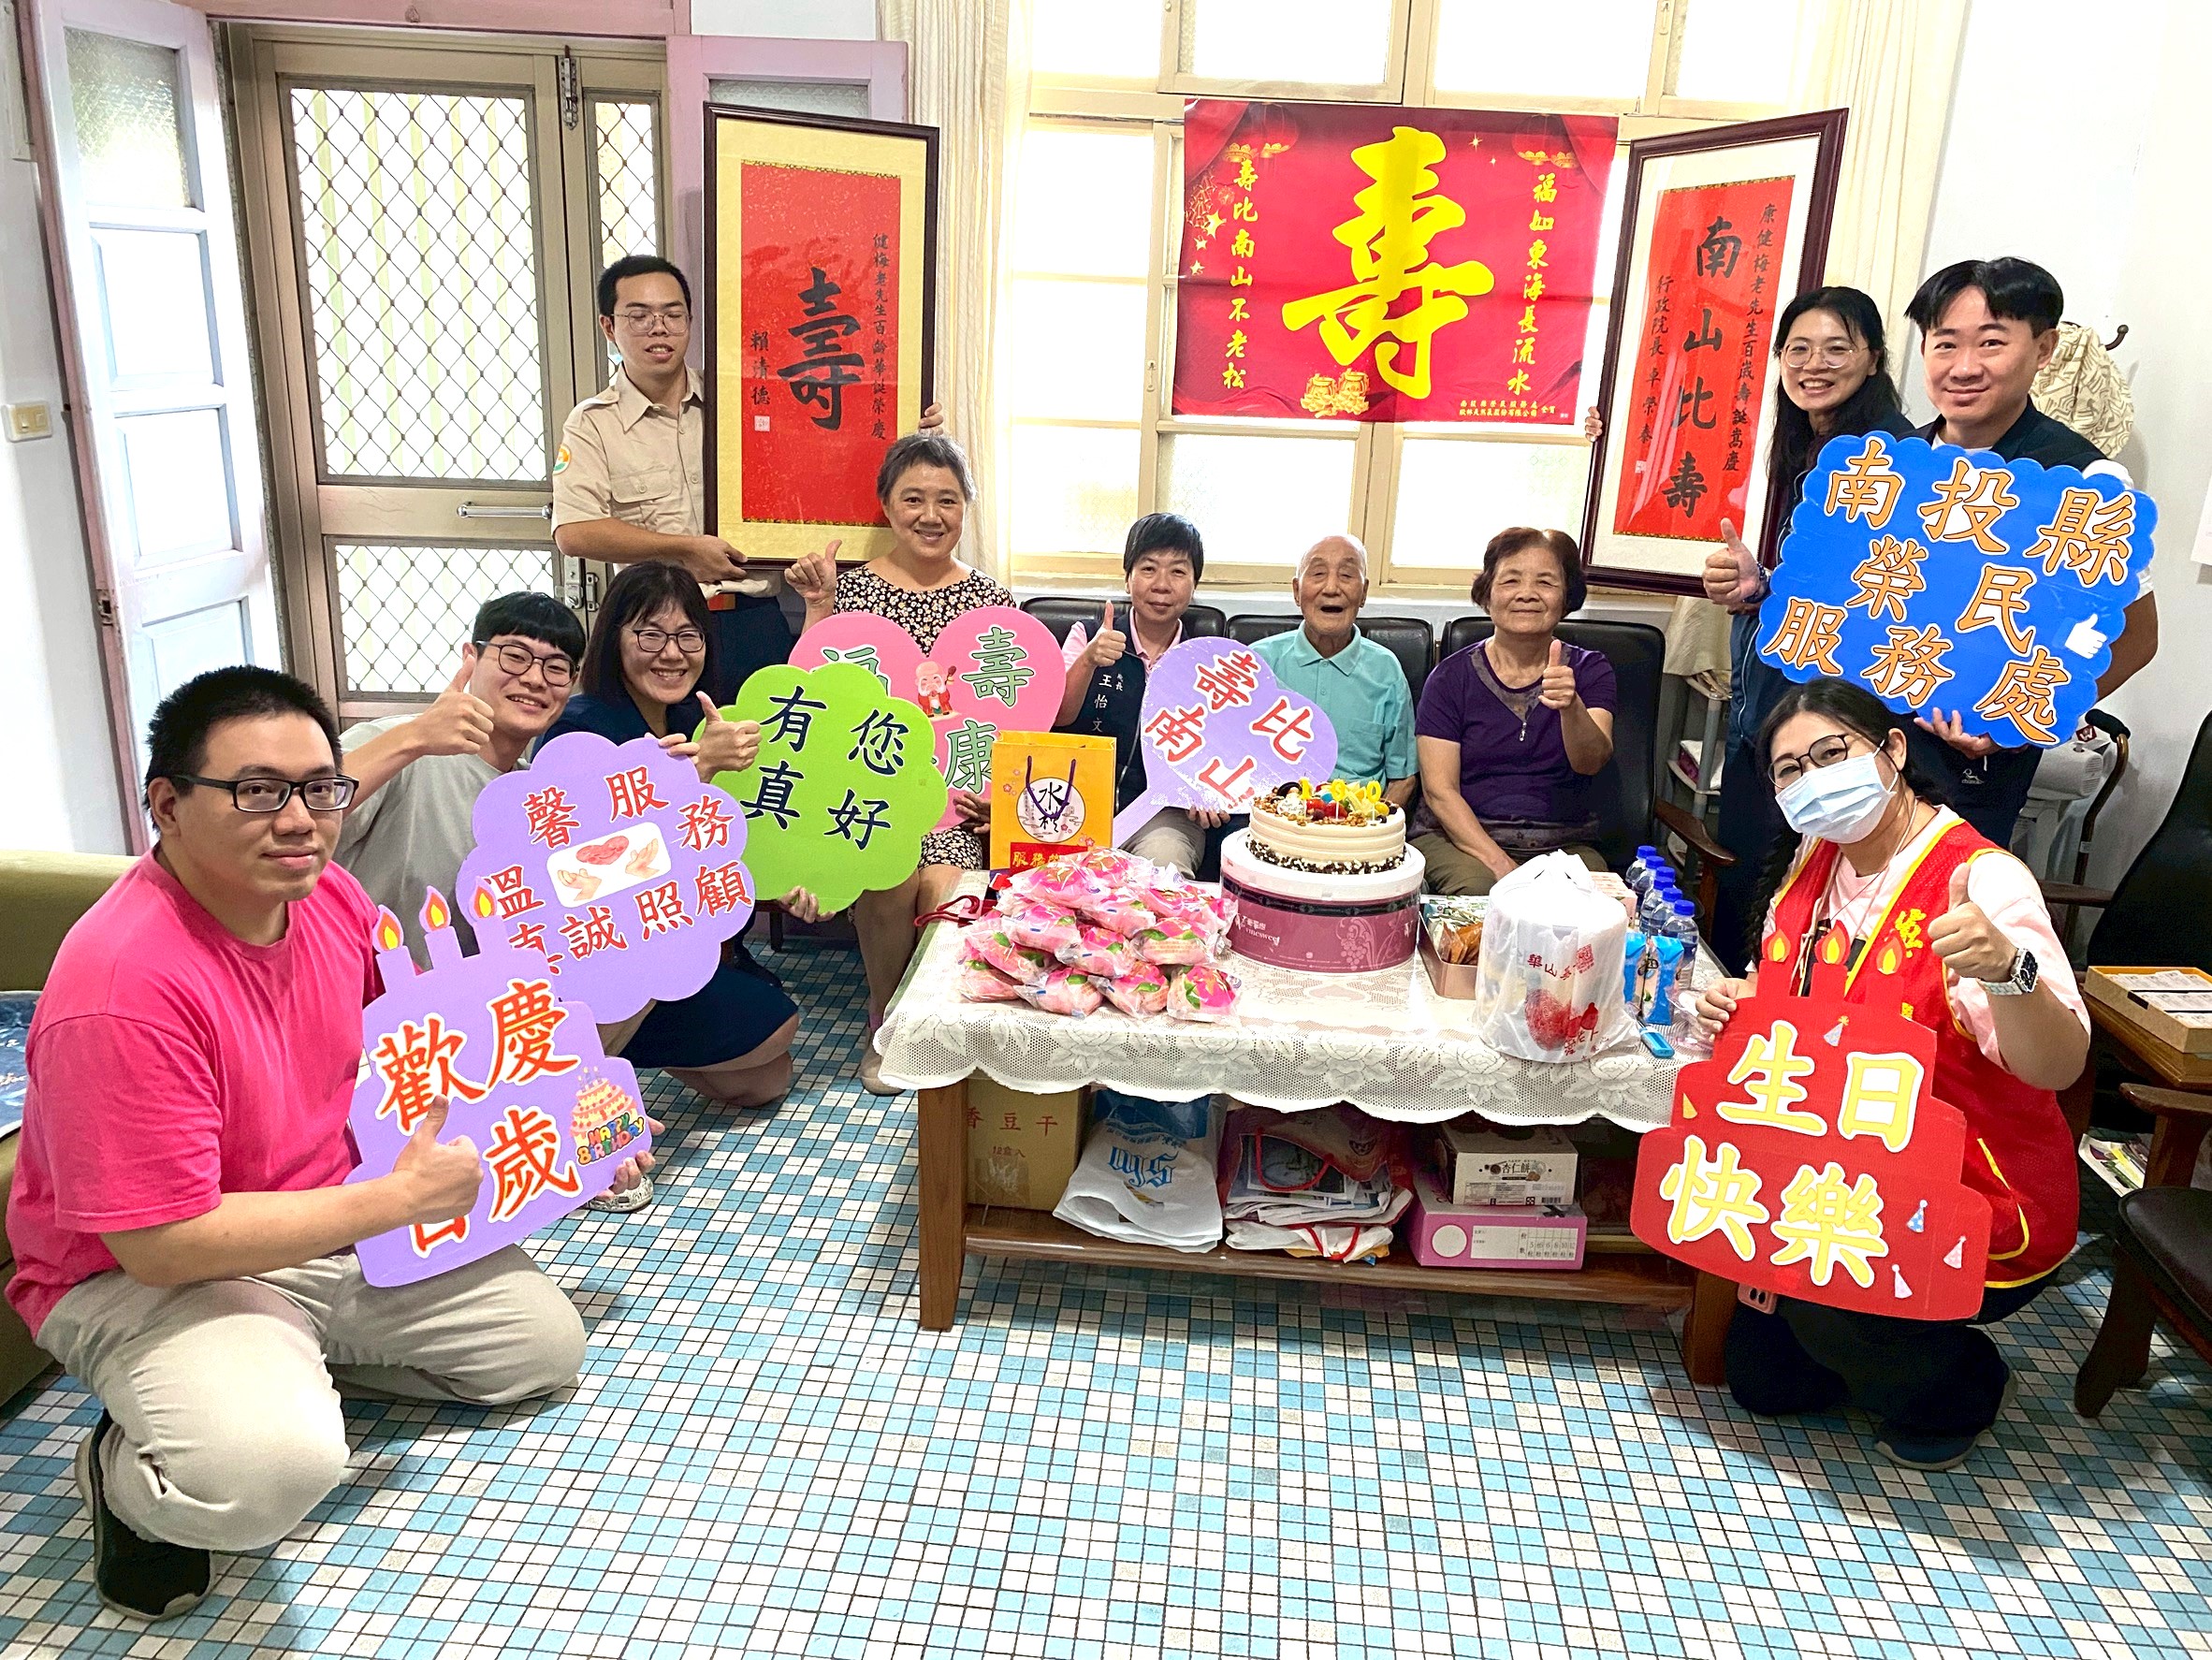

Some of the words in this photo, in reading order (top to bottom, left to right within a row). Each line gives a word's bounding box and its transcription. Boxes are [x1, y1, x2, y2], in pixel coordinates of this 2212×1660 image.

[1221, 158, 1259, 389] 壽比南山不老松
[1281, 126, 1495, 400] 壽
[1506, 173, 1557, 396] 福如東海長流水
[749, 329, 771, 406] 賴清德
[777, 268, 866, 431] 壽
[1662, 216, 1743, 519] 南山比壽
[1824, 439, 2135, 587] 南投縣
[1845, 535, 2038, 655] 榮民
[1092, 674, 1113, 733] 王怡文
[1764, 598, 2071, 744] 服務處
[375, 983, 580, 1130] 歡慶
[1720, 1023, 1921, 1149] 生日
[1663, 1138, 1887, 1286] 快樂
